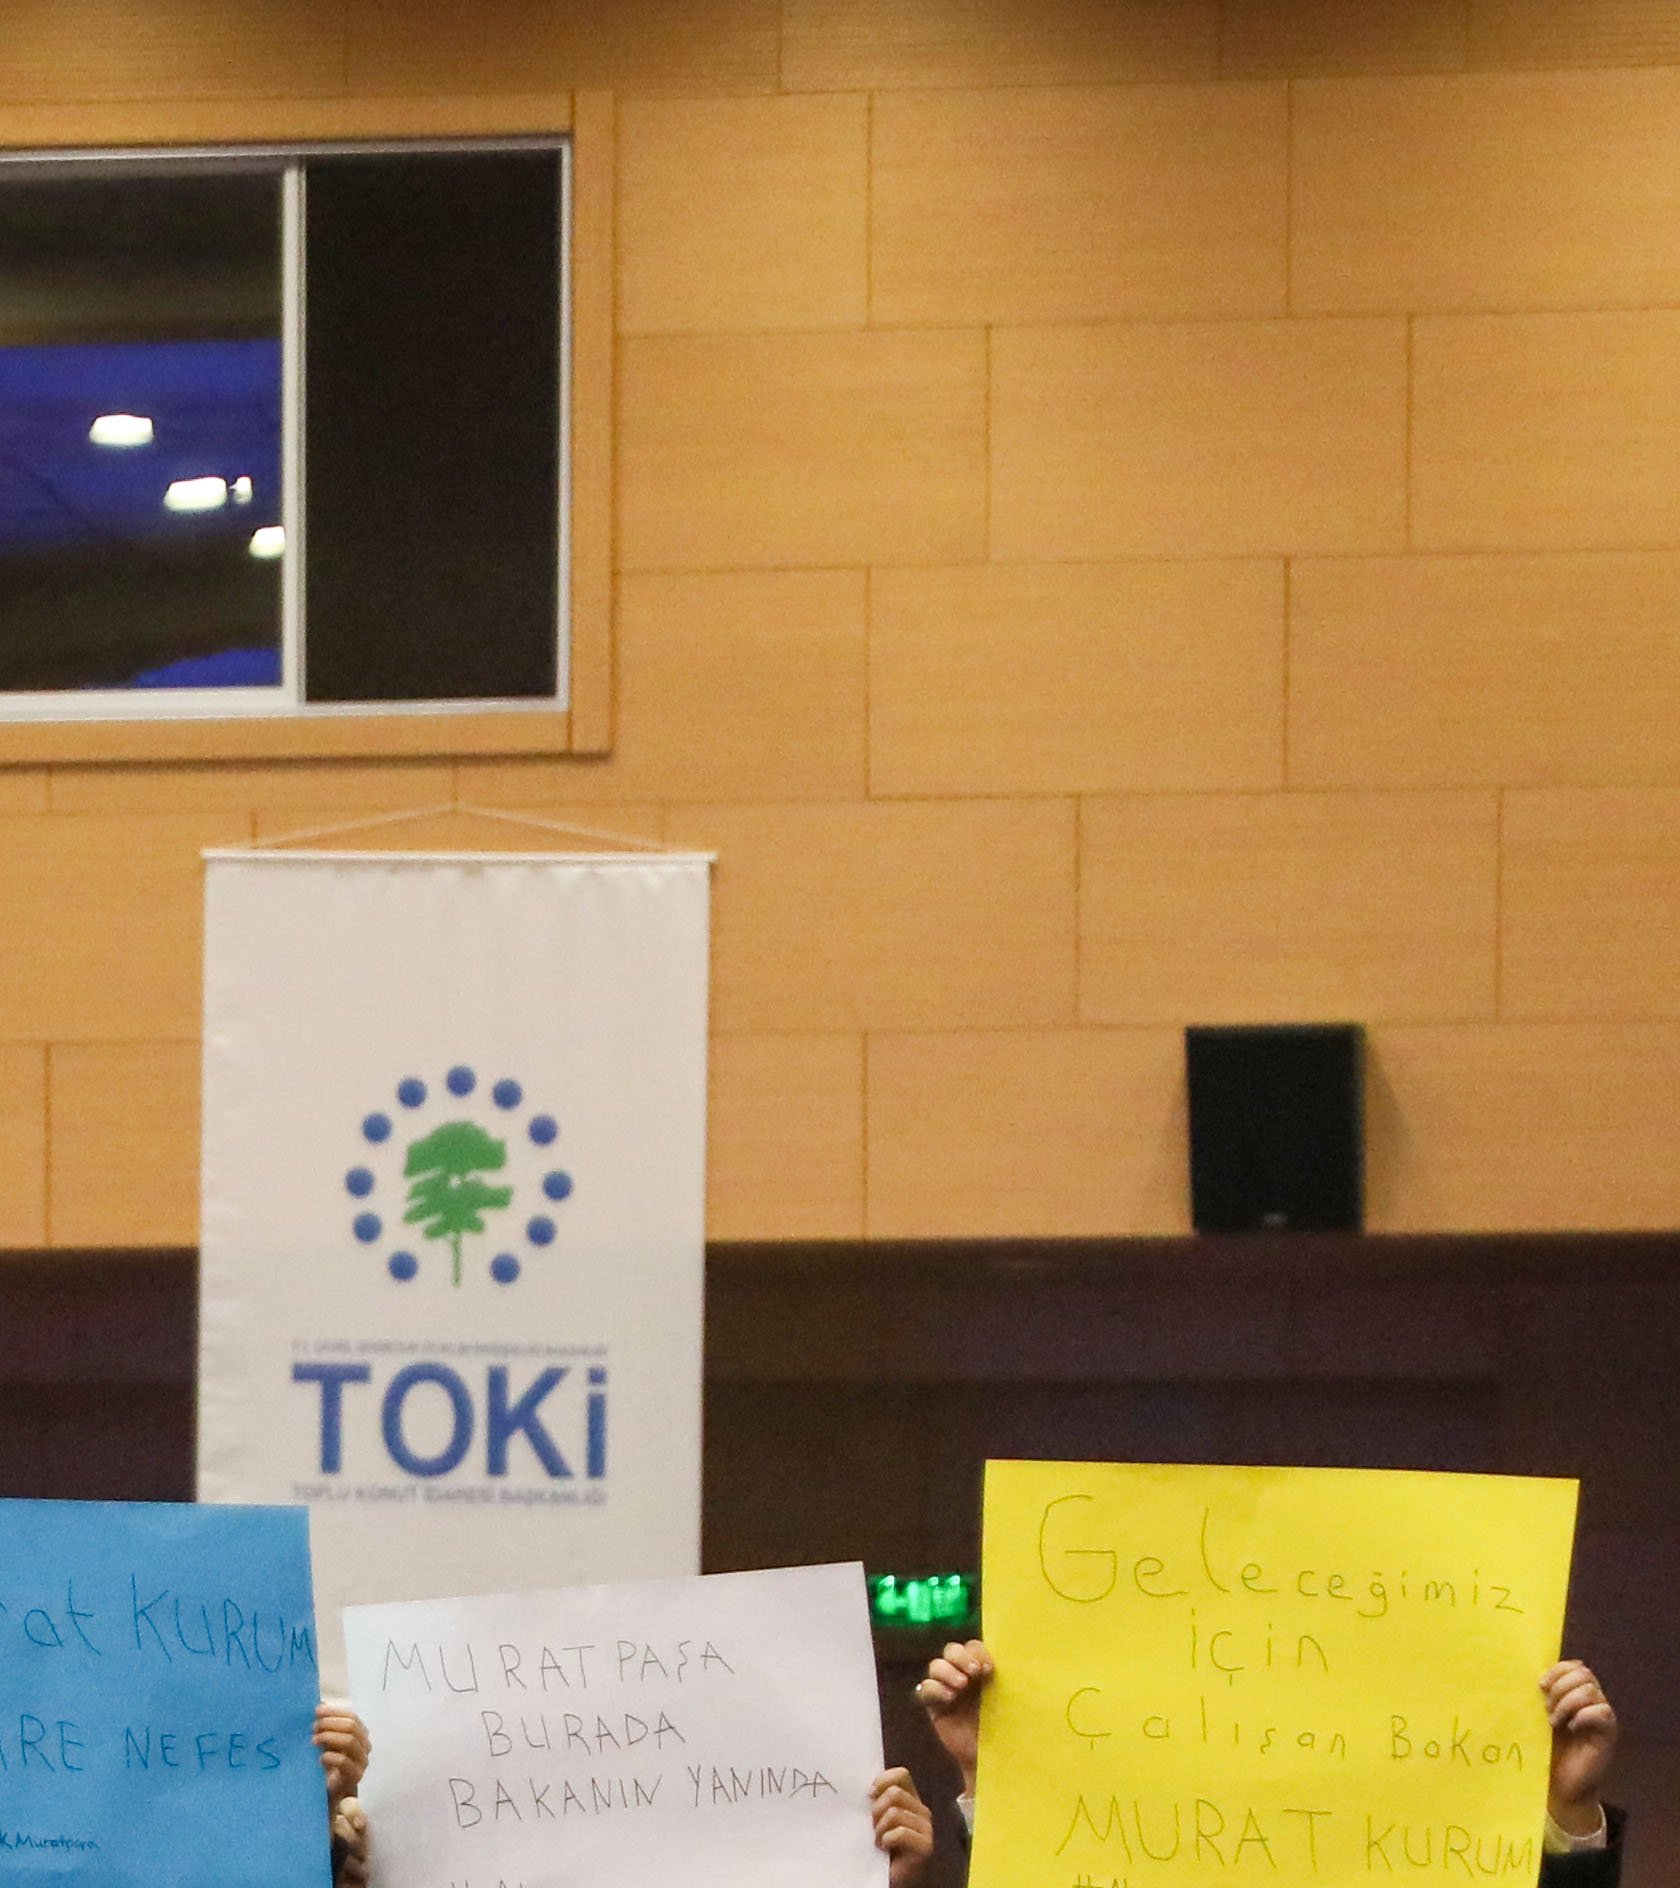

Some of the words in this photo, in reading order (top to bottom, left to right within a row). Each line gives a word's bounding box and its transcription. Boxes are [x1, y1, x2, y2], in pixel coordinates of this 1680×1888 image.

[130, 1573, 317, 1674] KURUM
[124, 1726, 282, 1771] NEFES
[481, 1710, 687, 1758] BURADA
[448, 1773, 663, 1829] BAKANIN
[687, 1765, 839, 1809] YANINDA
[1055, 1794, 1334, 1873] MURAT
[1366, 1815, 1534, 1877] KURUM
